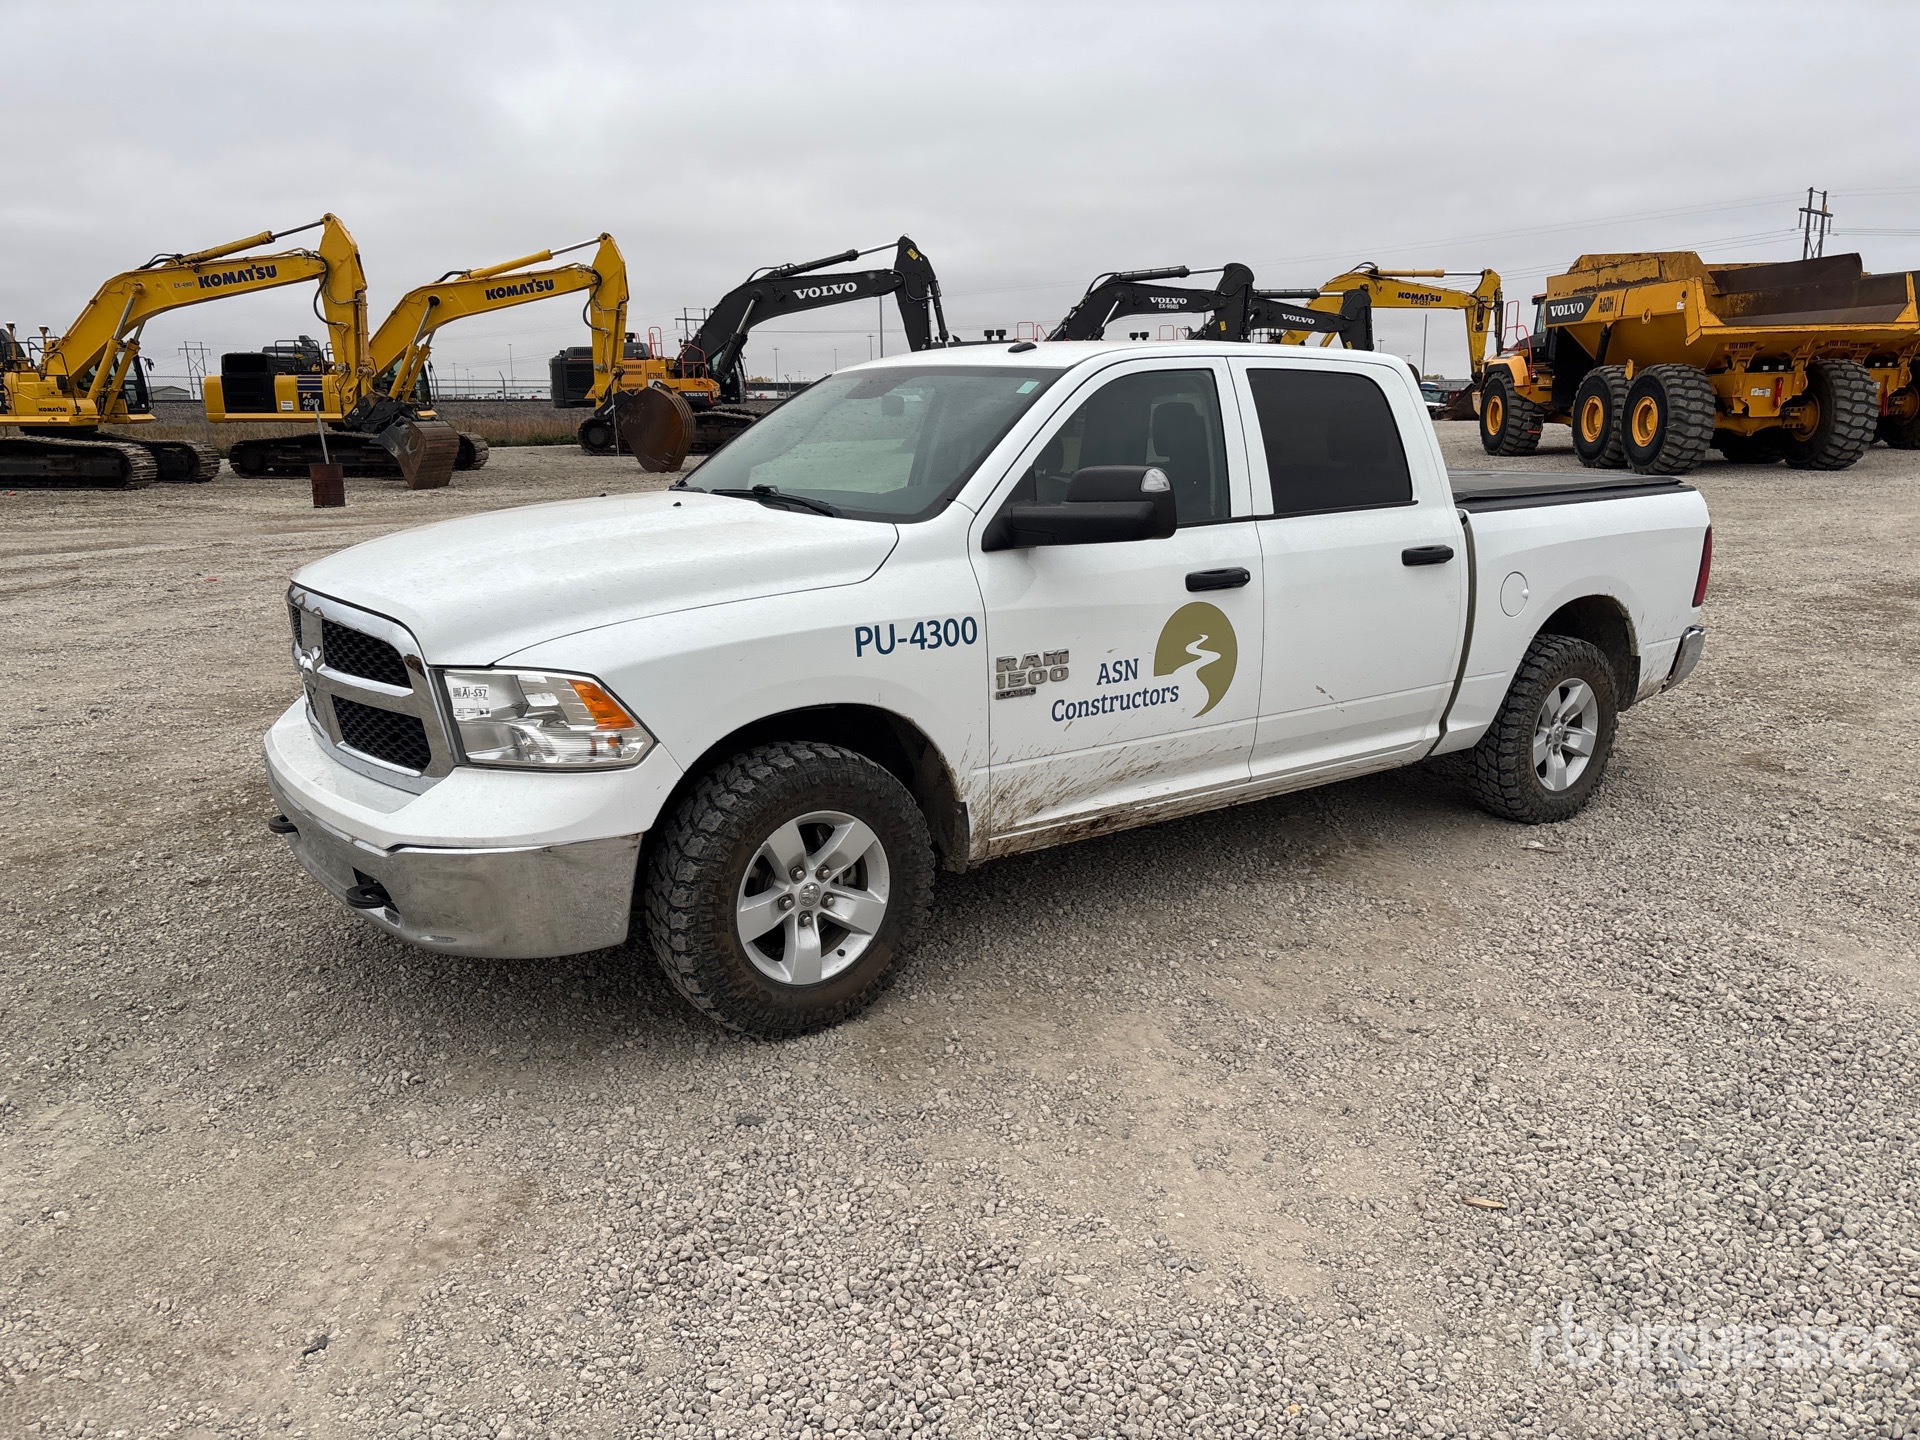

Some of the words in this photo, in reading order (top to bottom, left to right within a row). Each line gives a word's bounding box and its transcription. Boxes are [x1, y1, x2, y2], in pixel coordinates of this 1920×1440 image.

[198, 264, 277, 288] KOMATSU
[485, 279, 554, 300] KOMATSU
[792, 282, 857, 299] VOLVO
[1398, 291, 1442, 302] KOMATSU
[1149, 296, 1188, 304] VOLVO
[1549, 302, 1585, 317] VOLVO
[1281, 313, 1316, 325] VOLVO
[302, 398, 320, 406] 490
[855, 616, 978, 657] PU-4300
[996, 648, 1069, 672] RAM
[996, 666, 1069, 689] 1500
[1096, 658, 1139, 685] ASN
[997, 687, 1036, 699] CLASSIC
[1051, 685, 1180, 722] Constructors
